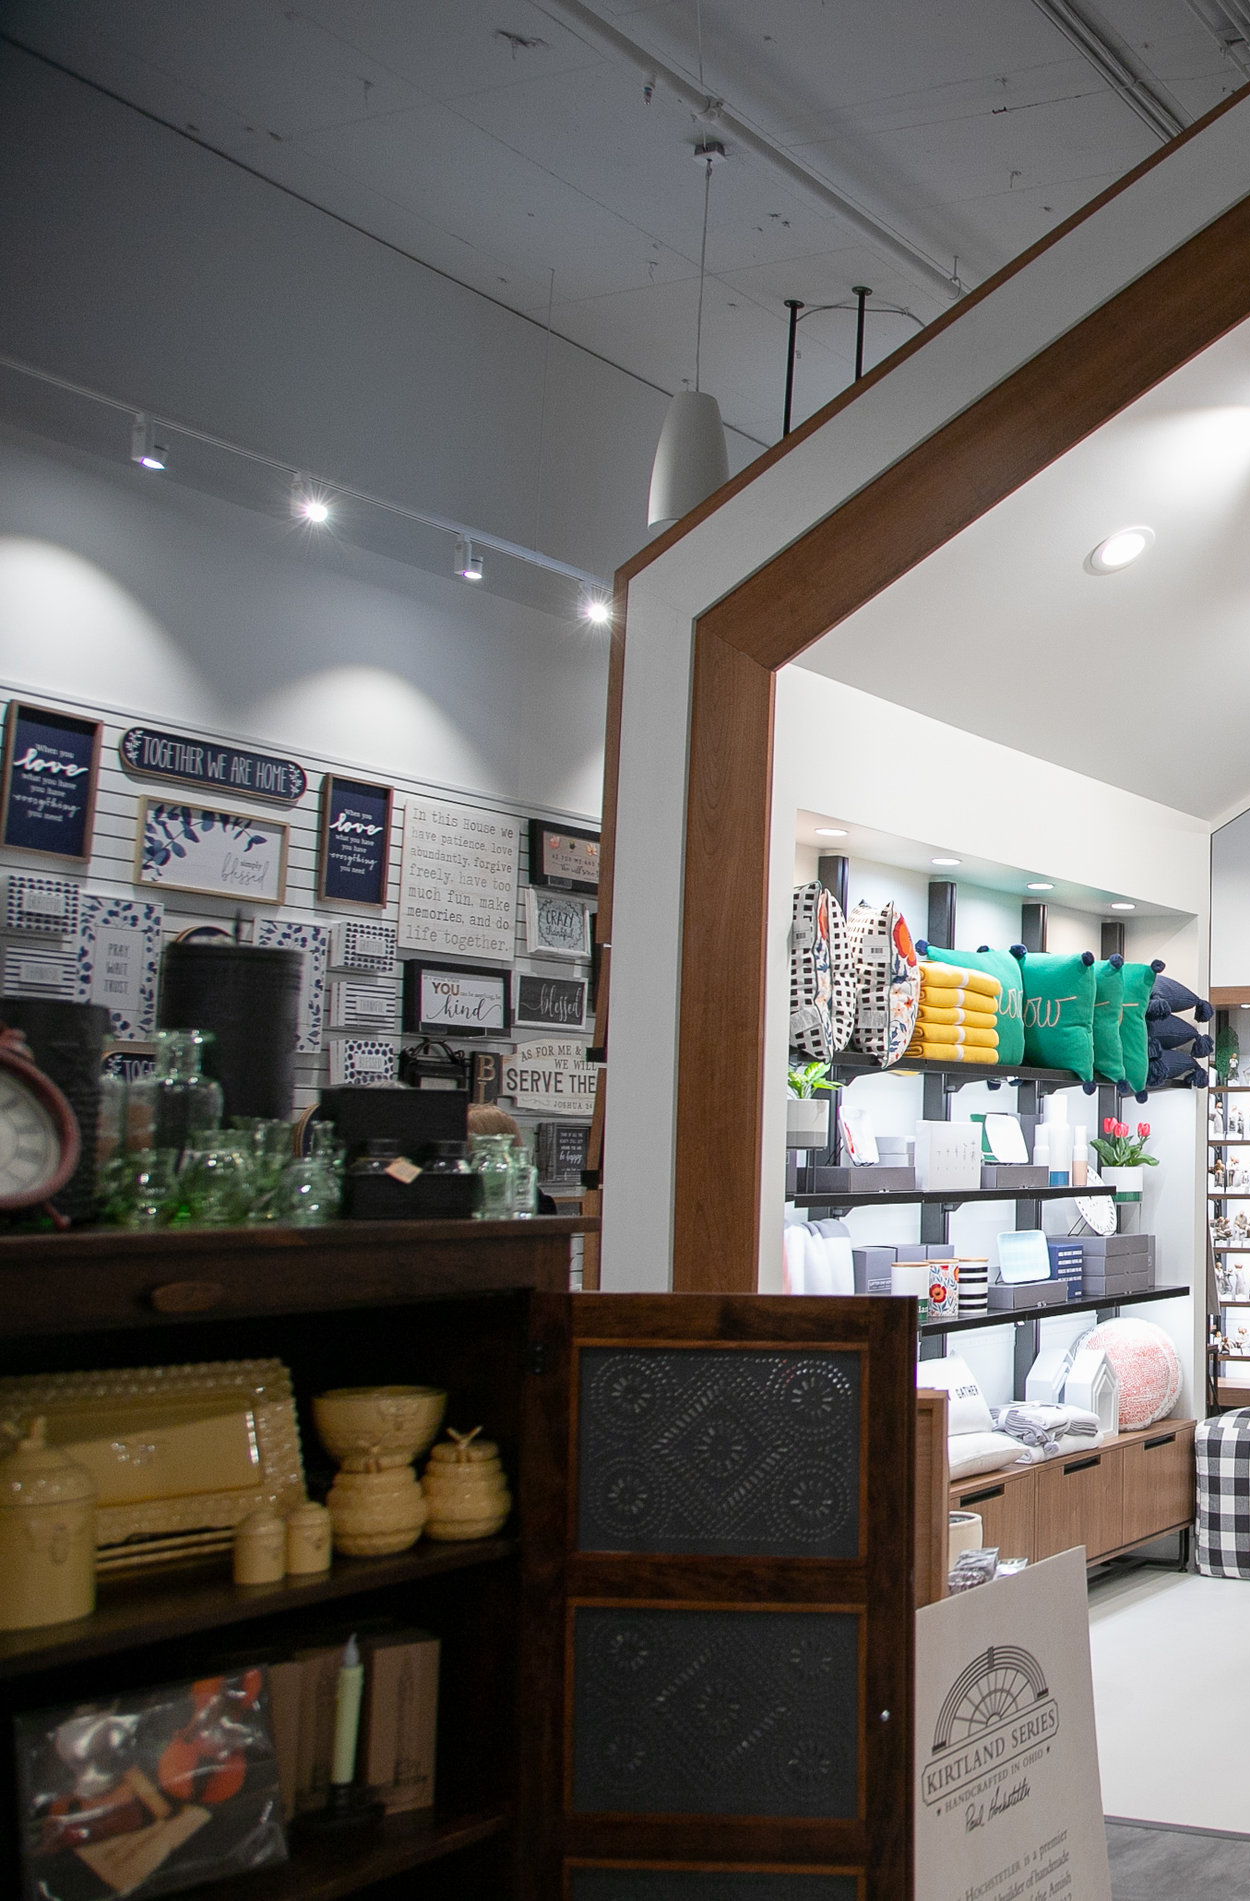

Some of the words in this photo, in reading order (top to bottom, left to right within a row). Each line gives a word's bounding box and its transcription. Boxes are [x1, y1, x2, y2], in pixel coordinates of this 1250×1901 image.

[13, 748, 89, 777] love
[60, 749, 74, 759] you
[143, 736, 204, 775] TOGETHER
[207, 751, 227, 780] WE
[230, 757, 252, 786] ARE
[256, 763, 288, 793] HOME
[22, 773, 42, 783] what
[42, 776, 57, 786] you
[58, 779, 77, 790] have
[30, 785, 45, 794] you
[47, 787, 66, 797] have
[12, 794, 81, 818] everything
[27, 809, 42, 819] you
[44, 813, 63, 823] need
[329, 812, 383, 835] love
[413, 807, 426, 821] In
[432, 811, 458, 828] this
[463, 818, 496, 835] House
[501, 827, 514, 839] we
[335, 834, 349, 842] what
[350, 836, 361, 844] you
[361, 838, 375, 847] have
[341, 844, 352, 852] you
[353, 846, 367, 854] have
[411, 827, 437, 842] have
[491, 842, 513, 857] love
[221, 852, 270, 890] blessed
[329, 852, 378, 871] everything
[340, 865, 351, 873] you
[352, 867, 366, 875] need
[410, 845, 471, 868] abundantly,
[473, 856, 512, 874] forgive
[409, 863, 454, 886] freely,
[459, 872, 488, 888] have
[493, 878, 511, 892] too
[408, 886, 441, 901] much
[448, 889, 474, 907] fun,
[479, 896, 510, 912] make
[406, 905, 465, 924] memories,
[469, 914, 491, 928] and
[496, 919, 510, 930] do
[546, 909, 574, 929] CRAZY
[406, 925, 438, 942] life
[444, 930, 509, 952] together.
[432, 981, 460, 996] YOU
[426, 994, 501, 1021] kind
[520, 984, 582, 1022] blessed
[1023, 995, 1078, 1028] ow
[521, 1049, 533, 1062] AS
[536, 1045, 554, 1058] FOR
[558, 1045, 571, 1056] ME
[575, 1046, 582, 1056] &
[554, 1059, 568, 1070] WE
[574, 1060, 597, 1071] WILL
[506, 1067, 563, 1094] SERVE
[569, 1074, 596, 1093] THE
[553, 1100, 582, 1110] JOSHUA
[955, 1385, 979, 1398] GATHER
[927, 1737, 1006, 1795] KIRTLAND
[1011, 1708, 1056, 1748] SERIES
[945, 1768, 1009, 1813] HANDCRAFTED
[1011, 1761, 1020, 1775] IN
[1022, 1750, 1043, 1769] OHIO
[1039, 1829, 1068, 1861] premier
[1034, 1849, 1069, 1884] handmade
[1049, 1870, 1072, 1898] Amish
